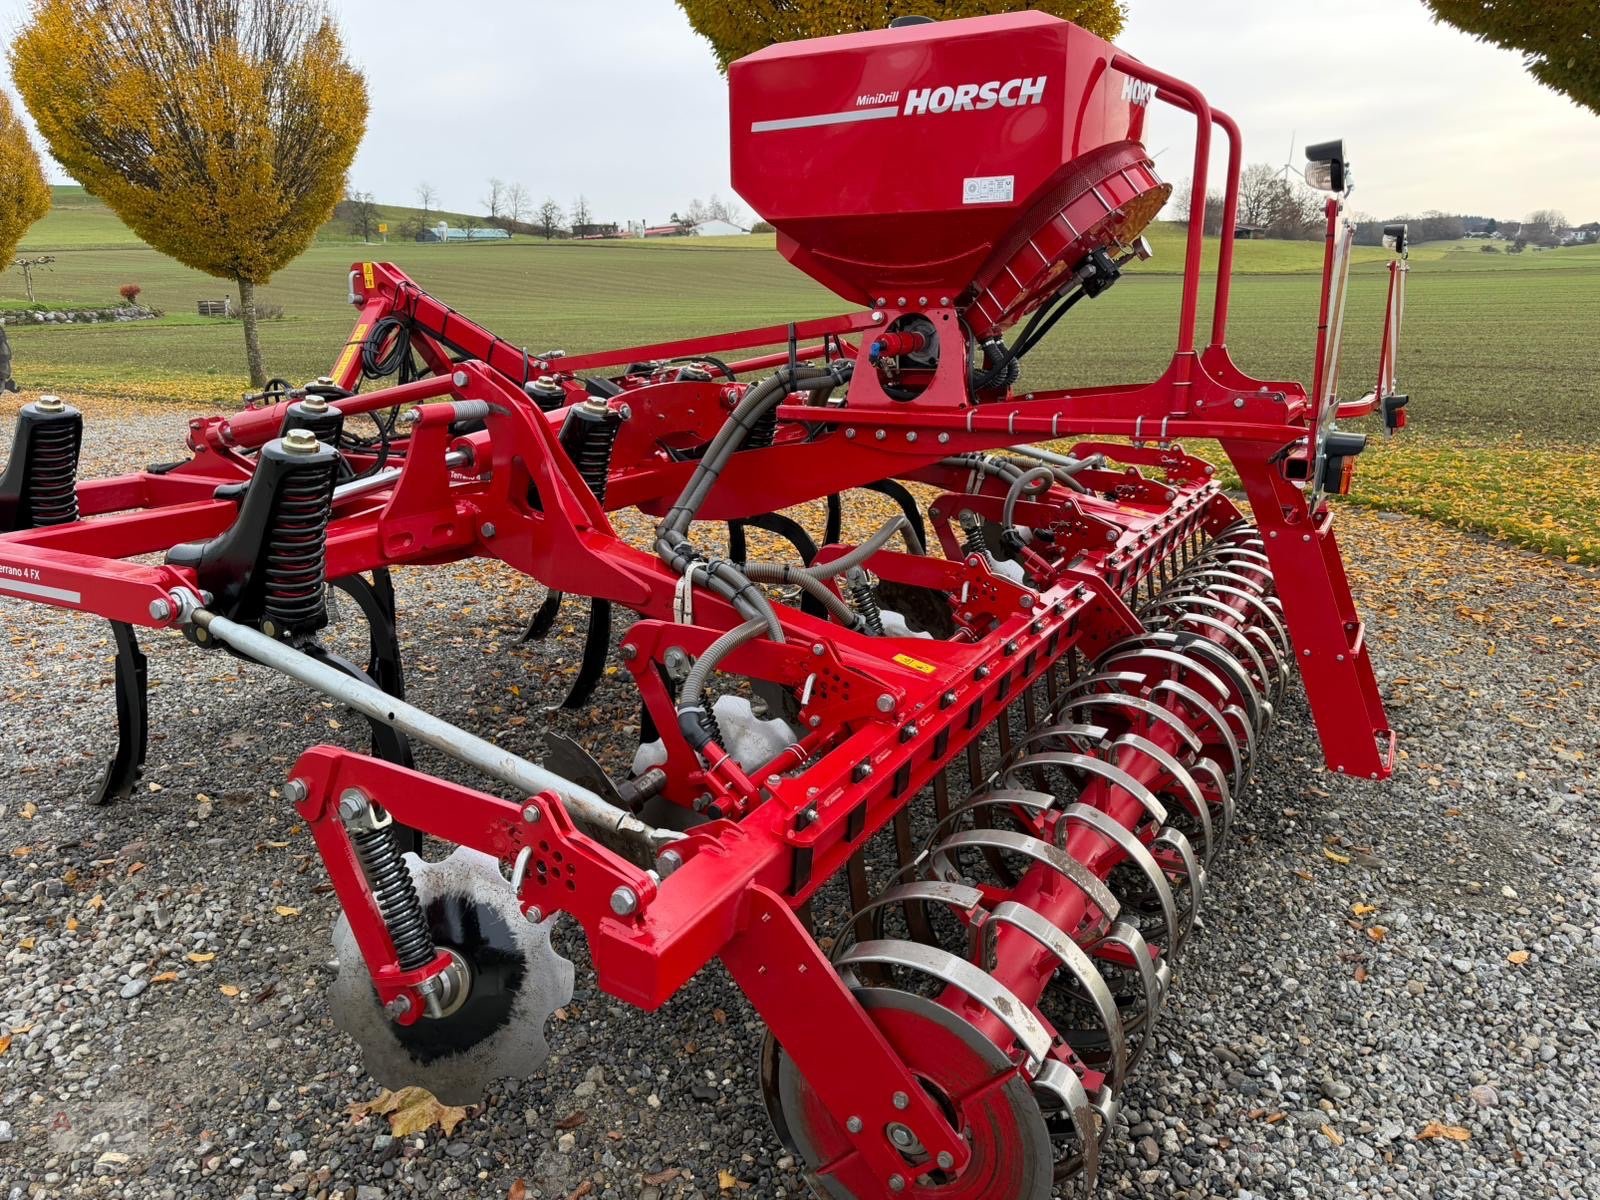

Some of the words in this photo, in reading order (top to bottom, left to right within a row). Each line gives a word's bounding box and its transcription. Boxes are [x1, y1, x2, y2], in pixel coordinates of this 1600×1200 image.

[856, 91, 900, 106] MiniDrill
[903, 75, 1048, 116] HORSCH
[1120, 75, 1153, 108] HORS
[0, 564, 22, 577] errano
[24, 568, 29, 577] 4
[30, 569, 40, 581] FX
